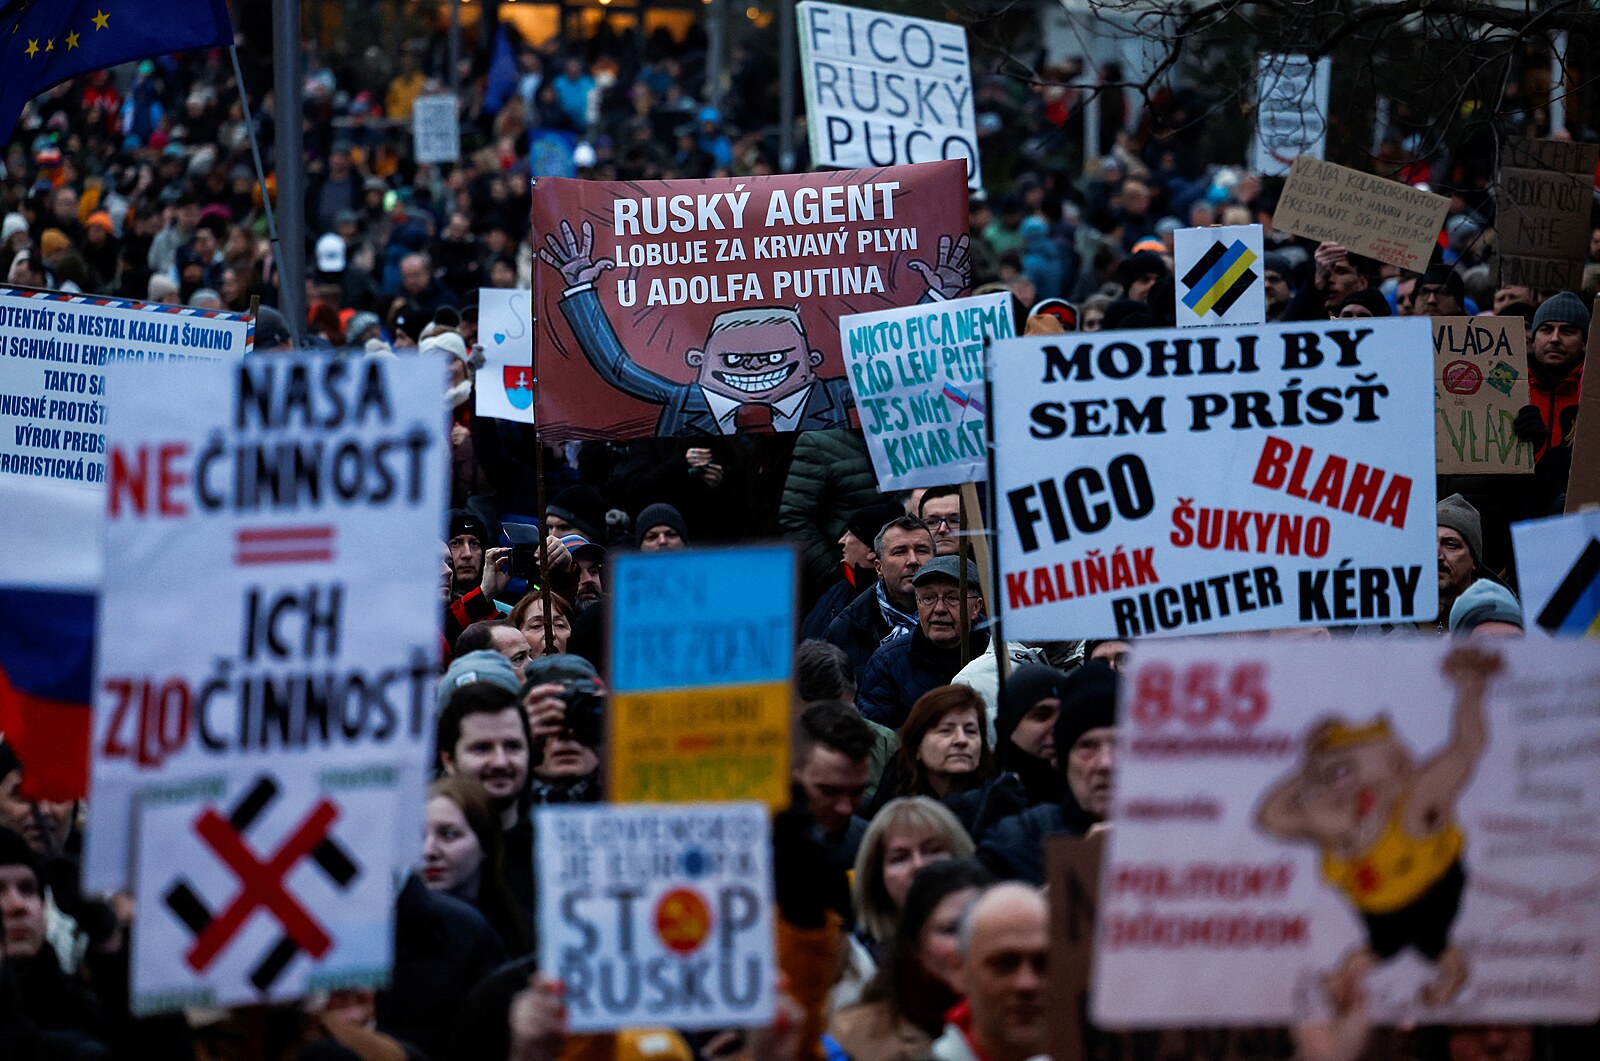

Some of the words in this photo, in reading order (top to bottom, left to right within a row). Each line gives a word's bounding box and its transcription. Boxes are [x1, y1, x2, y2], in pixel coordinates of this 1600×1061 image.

[814, 62, 969, 128] RUSKÝ
[613, 184, 751, 236] RUSKÝ
[765, 181, 900, 227] AGENT
[615, 239, 708, 267] LOBUJE
[715, 238, 747, 262] ZA
[754, 226, 849, 260] KRVAVÝ
[858, 227, 917, 253] PLYN
[617, 279, 636, 307] U
[647, 273, 764, 306] ADOLFA
[773, 265, 885, 299] PUTINA
[9, 336, 79, 363] SCHVÁLILI
[57, 312, 75, 334] SA
[78, 315, 125, 339] NESTAL
[128, 320, 167, 344] KAALI
[169, 325, 179, 345] A
[182, 322, 233, 351] ŠUKINO
[849, 321, 902, 360] NIKTO
[1040, 335, 1261, 384] MOHLI
[1281, 328, 1374, 370] BY
[1432, 318, 1514, 357] VLÁDA
[44, 369, 87, 394] TAKTO
[852, 354, 894, 397] RÁD
[0, 395, 46, 419] NUSNÉ
[48, 400, 109, 425] PROTIŠT
[1029, 396, 1168, 440] SEM
[1187, 373, 1389, 431] PRÍSŤ
[15, 423, 61, 450] VÝROK
[882, 420, 987, 477] KAMARÁT
[0, 453, 84, 481] RORISTICKÁ
[1252, 435, 1414, 530] BLAHA
[1006, 452, 1155, 554] FICO
[1170, 497, 1331, 559] ŠUKYNO
[1005, 544, 1160, 610] KALIŇÁK
[1112, 566, 1283, 638] RICHTER
[1297, 558, 1422, 622] KÉRY
[243, 581, 344, 660] ICH
[1130, 660, 1269, 728] 855
